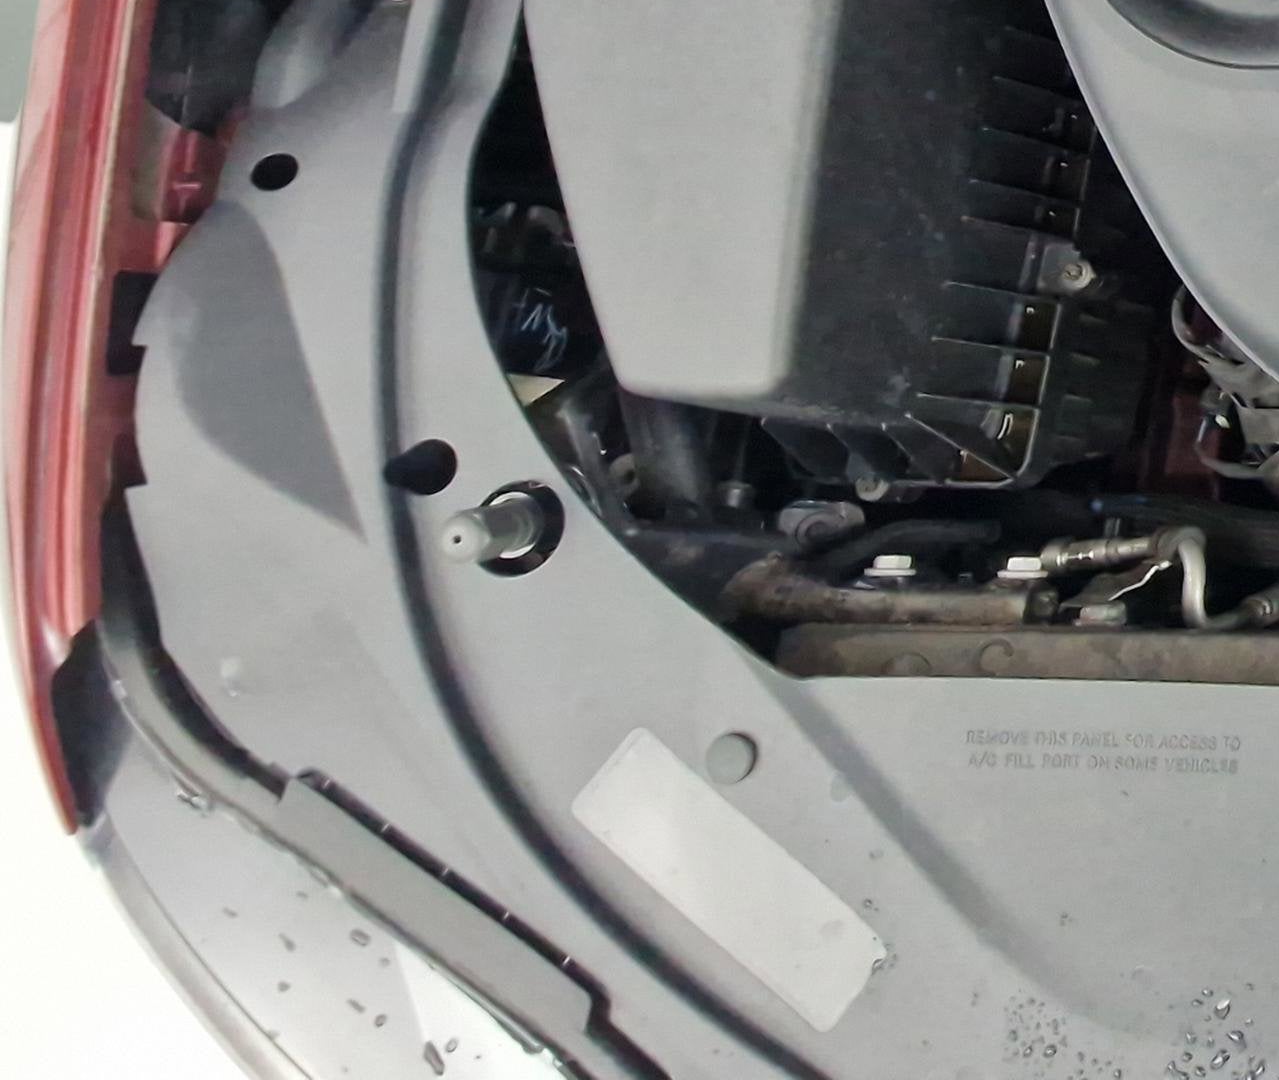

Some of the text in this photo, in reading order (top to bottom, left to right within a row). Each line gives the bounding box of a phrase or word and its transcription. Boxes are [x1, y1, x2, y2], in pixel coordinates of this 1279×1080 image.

[1072, 731, 1119, 749] PANEL
[1222, 735, 1241, 752] TO
[1004, 752, 1035, 770] FILL
[1042, 753, 1081, 770] PORT
